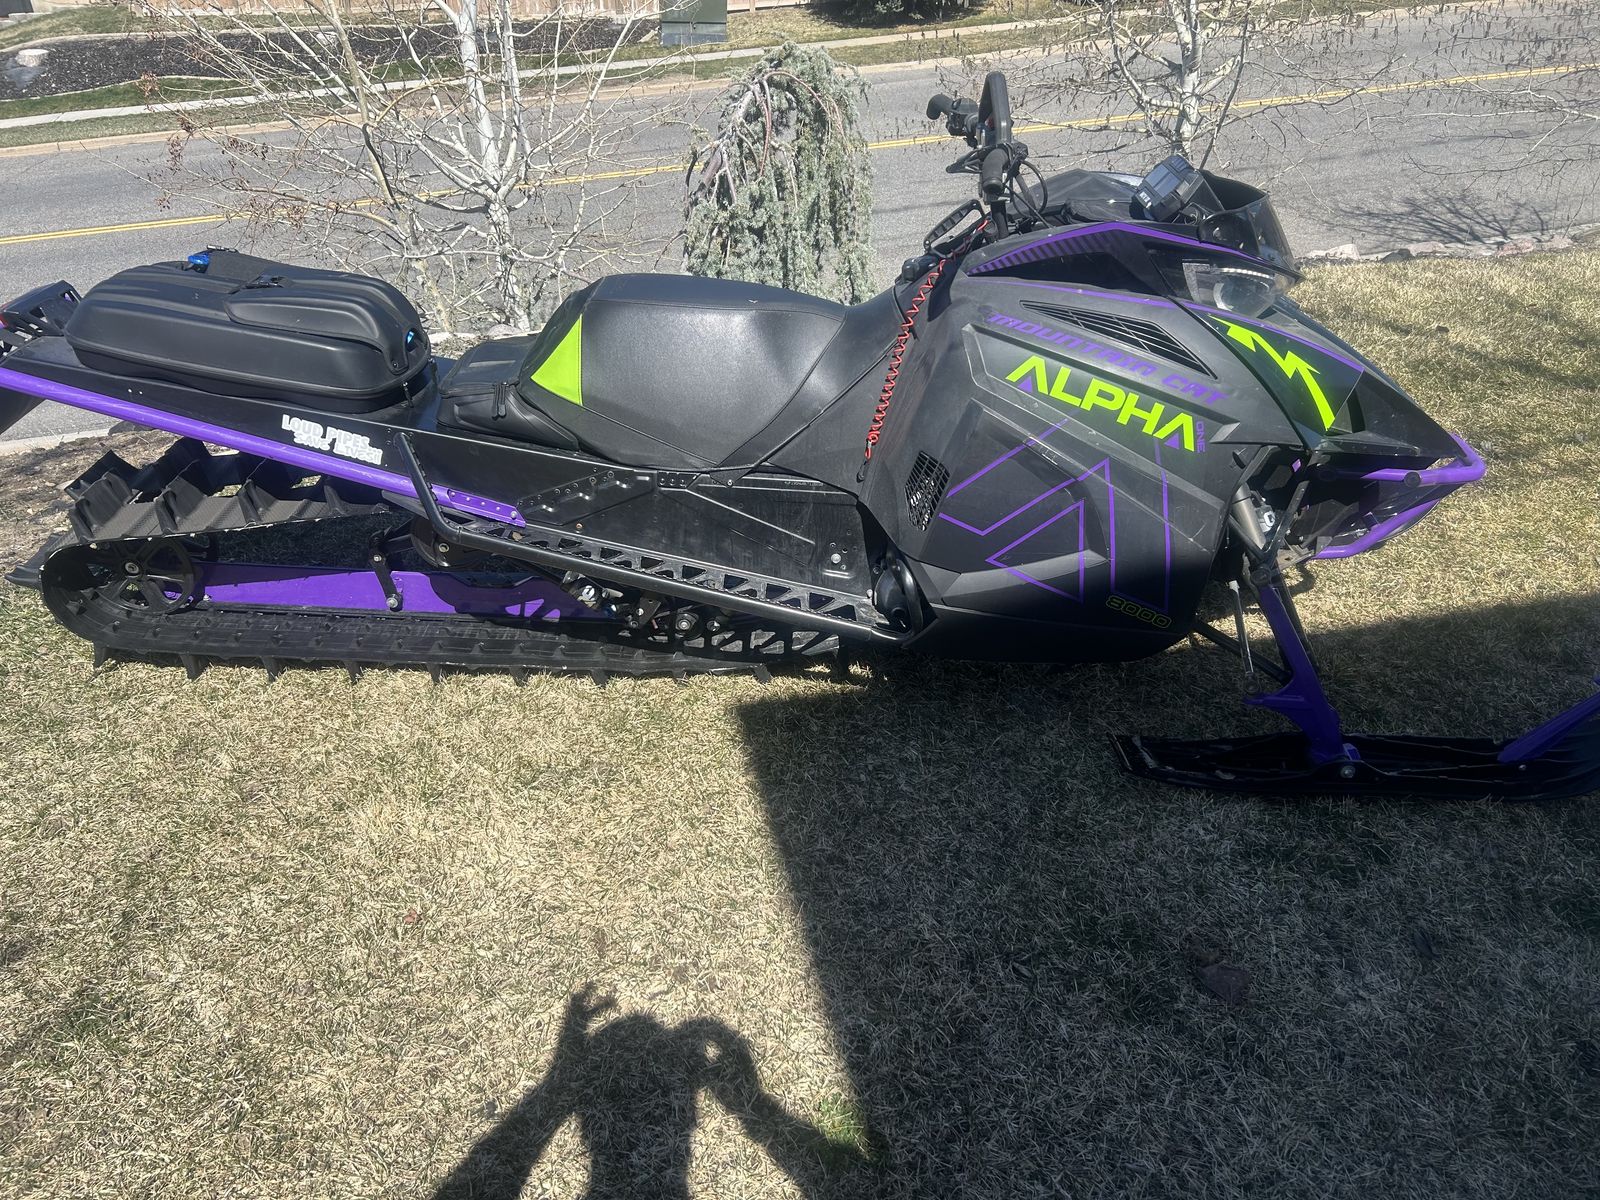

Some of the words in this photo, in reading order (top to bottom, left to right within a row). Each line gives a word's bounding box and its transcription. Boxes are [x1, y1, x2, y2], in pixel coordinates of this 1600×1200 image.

[1005, 355, 1195, 452] ALPHA
[282, 414, 324, 440] LOUD
[1196, 421, 1206, 454] ONE
[1106, 595, 1172, 629] 8000
